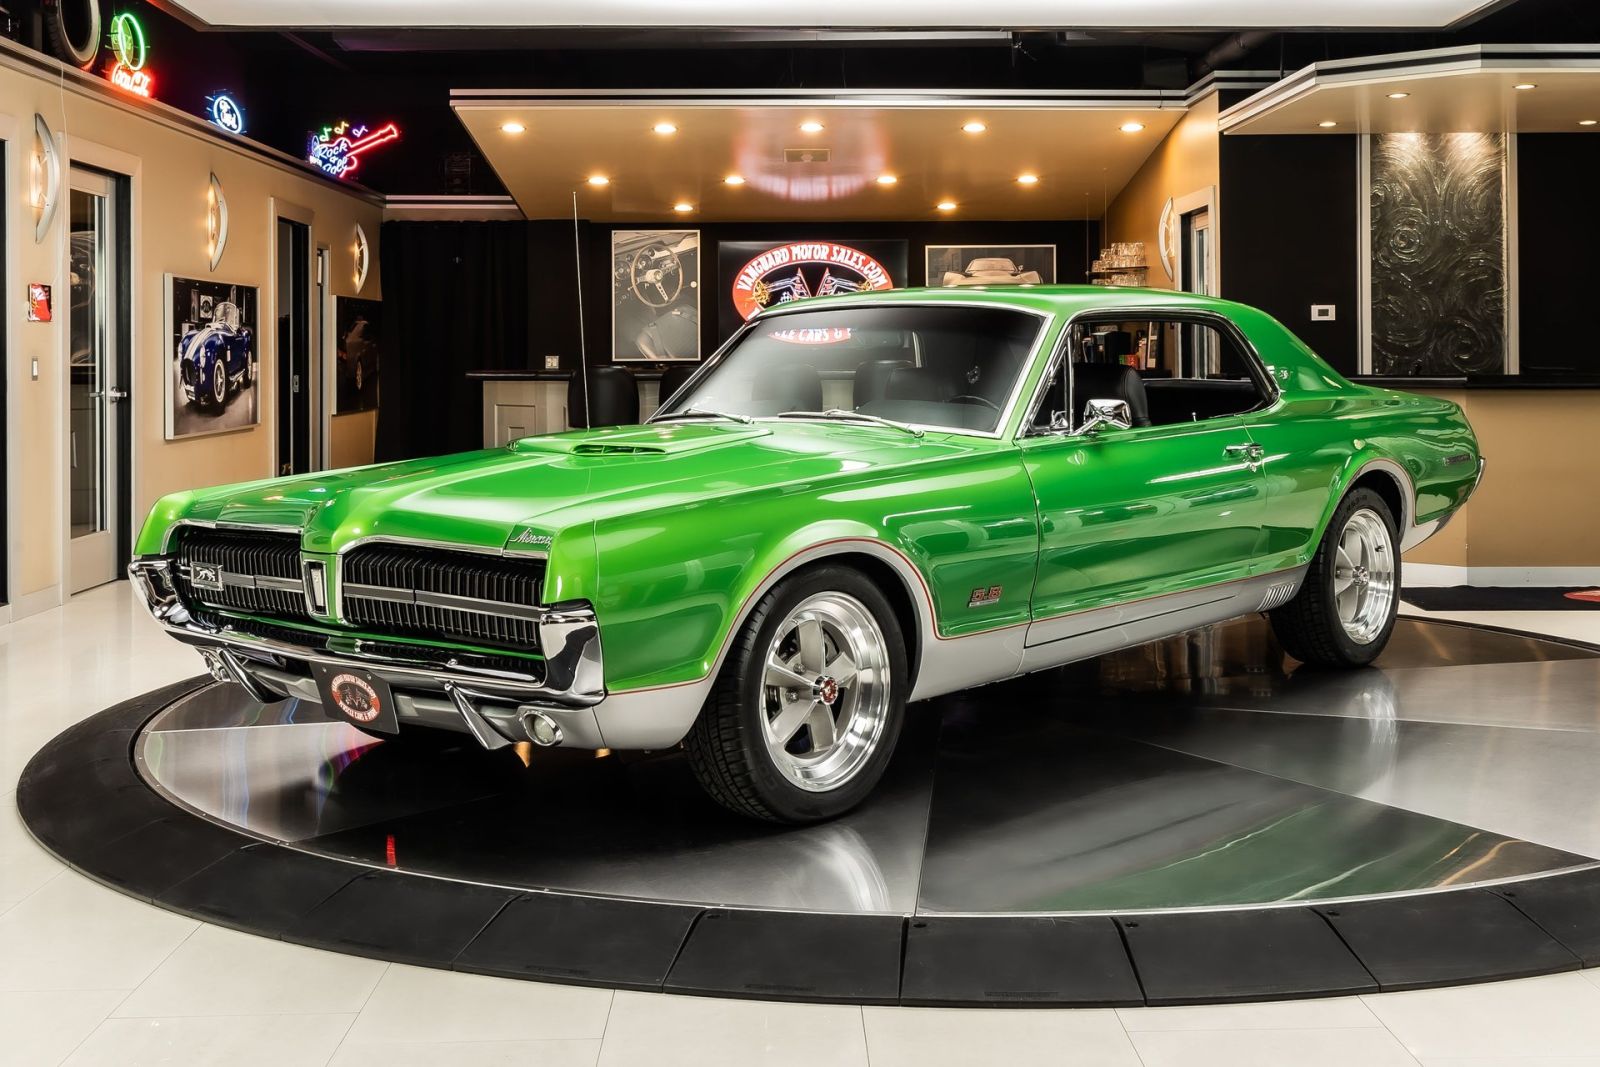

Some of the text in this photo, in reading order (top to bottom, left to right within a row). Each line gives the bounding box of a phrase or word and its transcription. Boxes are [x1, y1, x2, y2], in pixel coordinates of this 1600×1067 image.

[315, 140, 348, 159] Rock
[736, 244, 889, 291] VANGUARD MOTOR SALES.COM
[799, 328, 829, 342] CARS
[509, 527, 553, 550] Mercury
